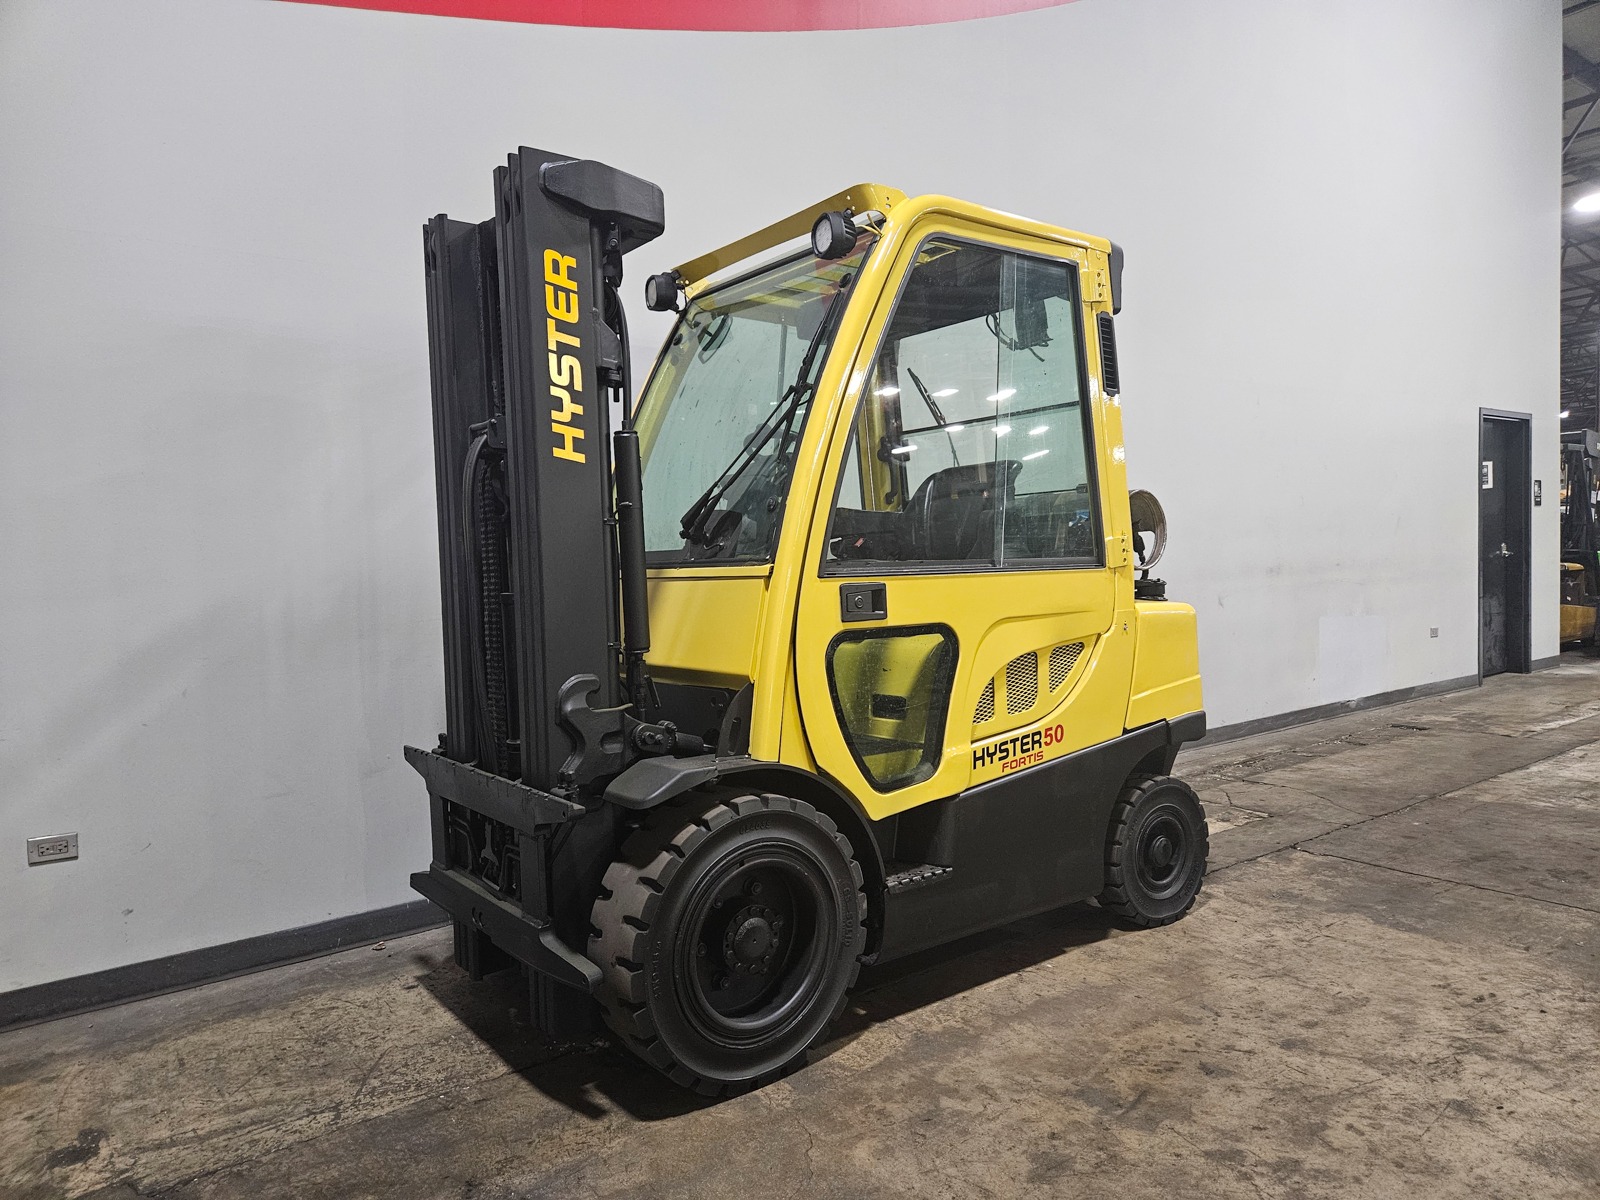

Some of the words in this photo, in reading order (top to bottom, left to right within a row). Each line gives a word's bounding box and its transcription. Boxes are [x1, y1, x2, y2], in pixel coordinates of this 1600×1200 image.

[543, 248, 586, 464] HYSTER
[972, 730, 1042, 770] HYSTER
[1043, 724, 1064, 747] 50
[1001, 750, 1044, 773] FORTIS
